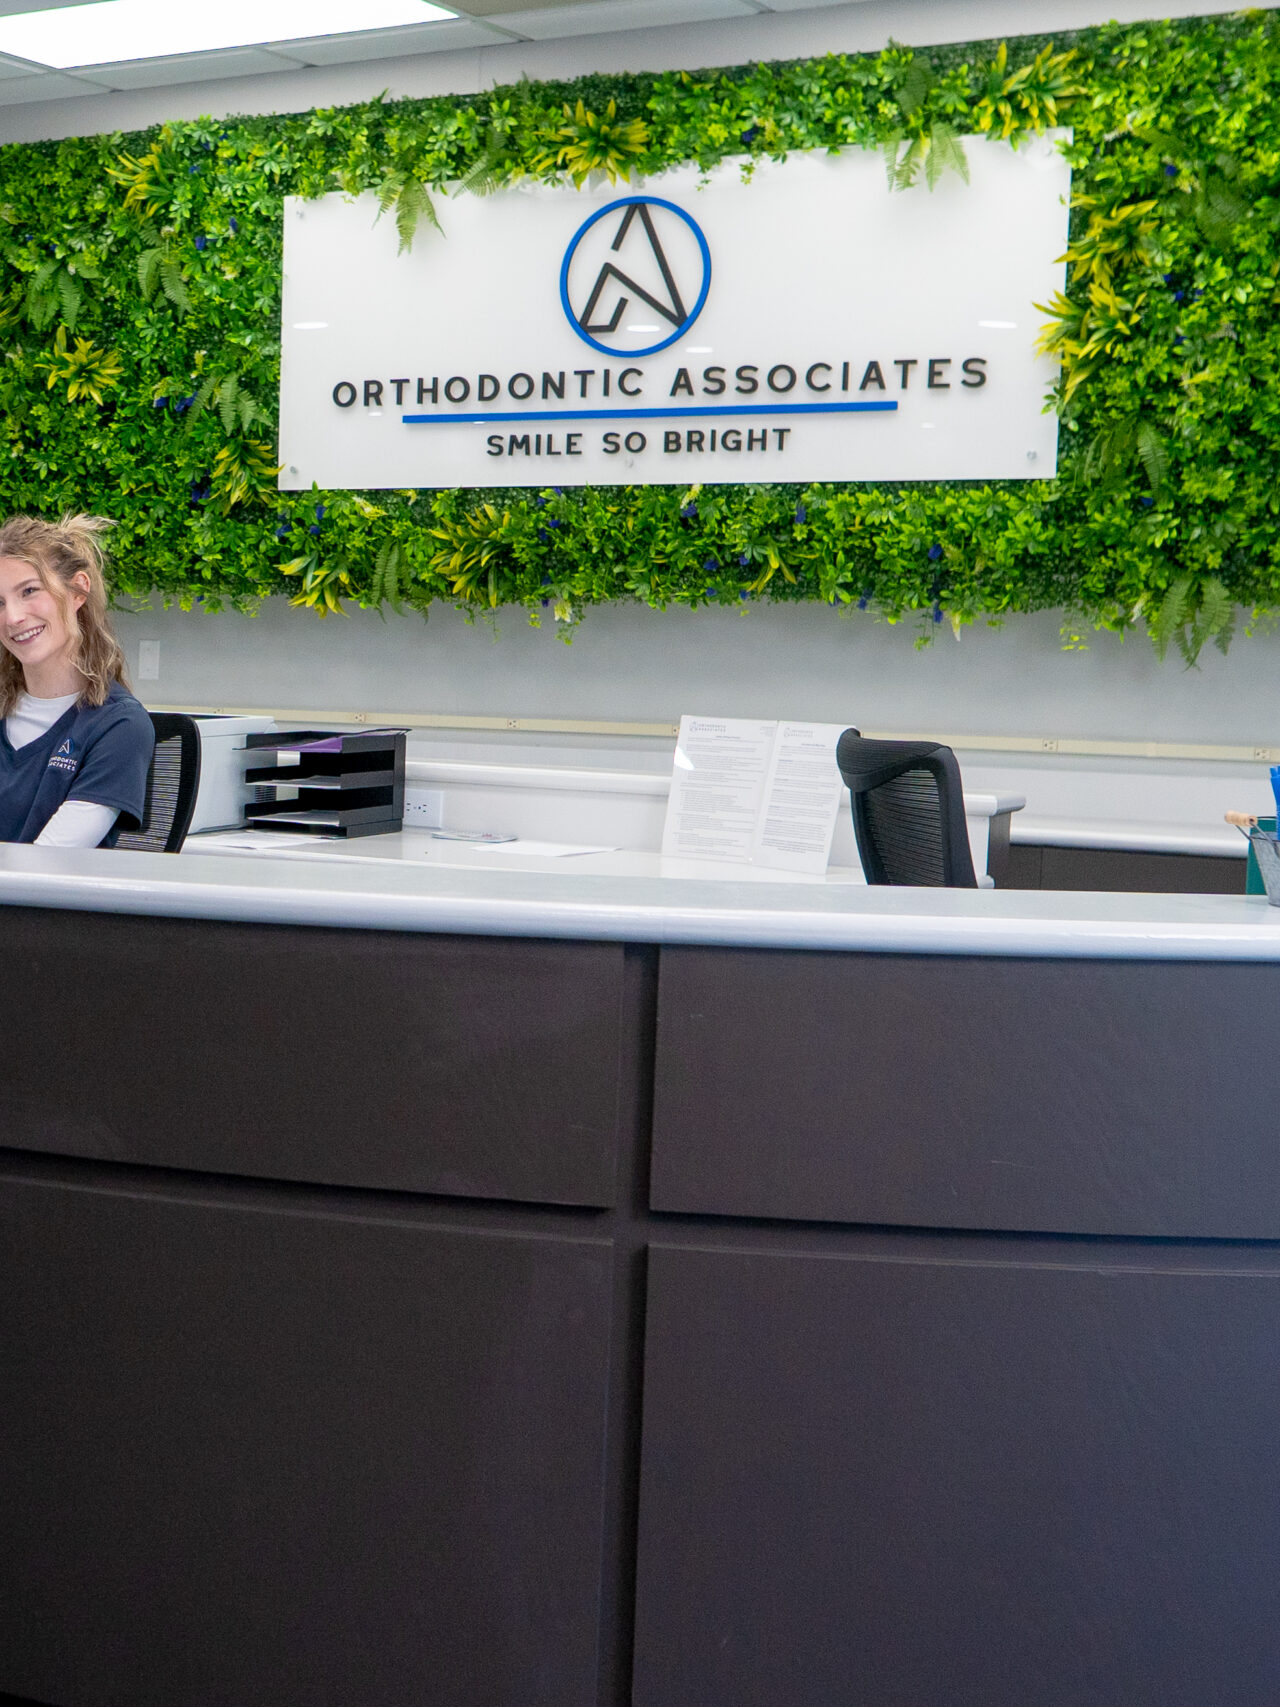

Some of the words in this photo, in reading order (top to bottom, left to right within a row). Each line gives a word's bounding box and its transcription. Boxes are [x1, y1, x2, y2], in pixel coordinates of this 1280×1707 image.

[333, 368, 643, 408] ORTHODONTIC
[669, 357, 988, 397] ASSOCIATES
[486, 432, 583, 456] SMILE
[602, 431, 647, 454] SO
[663, 428, 791, 453] BRIGHT
